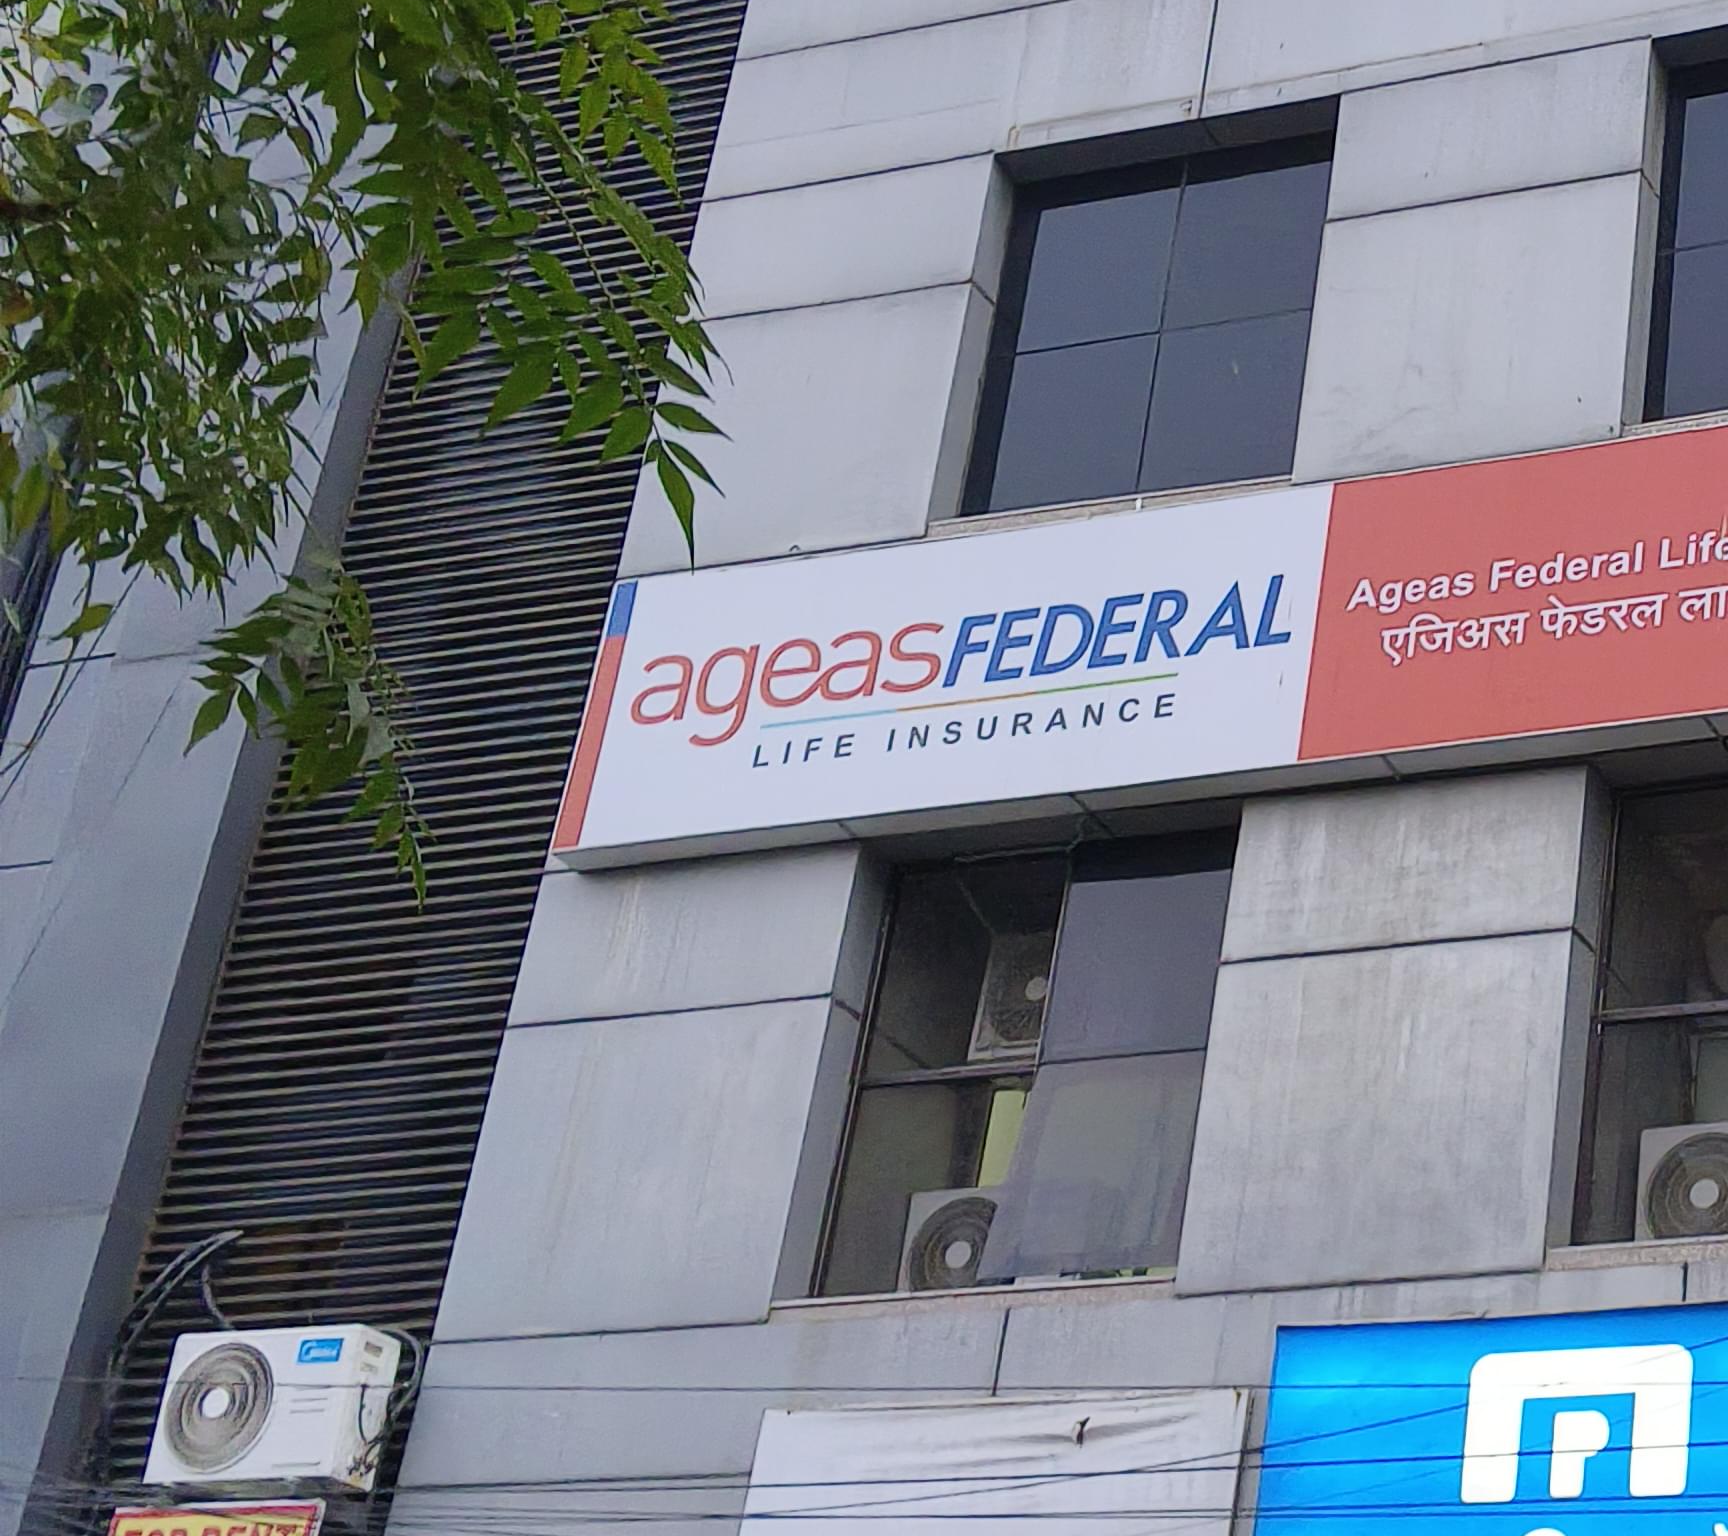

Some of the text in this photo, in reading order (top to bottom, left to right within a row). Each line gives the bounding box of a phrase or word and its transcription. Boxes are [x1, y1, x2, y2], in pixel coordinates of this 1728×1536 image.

[1345, 569, 1475, 613] Ageas
[1488, 541, 1645, 592] Federal
[1381, 611, 1530, 666] एजिअस
[1540, 594, 1669, 640] फेडरल
[751, 692, 1179, 769] LIFE INSURANCE
